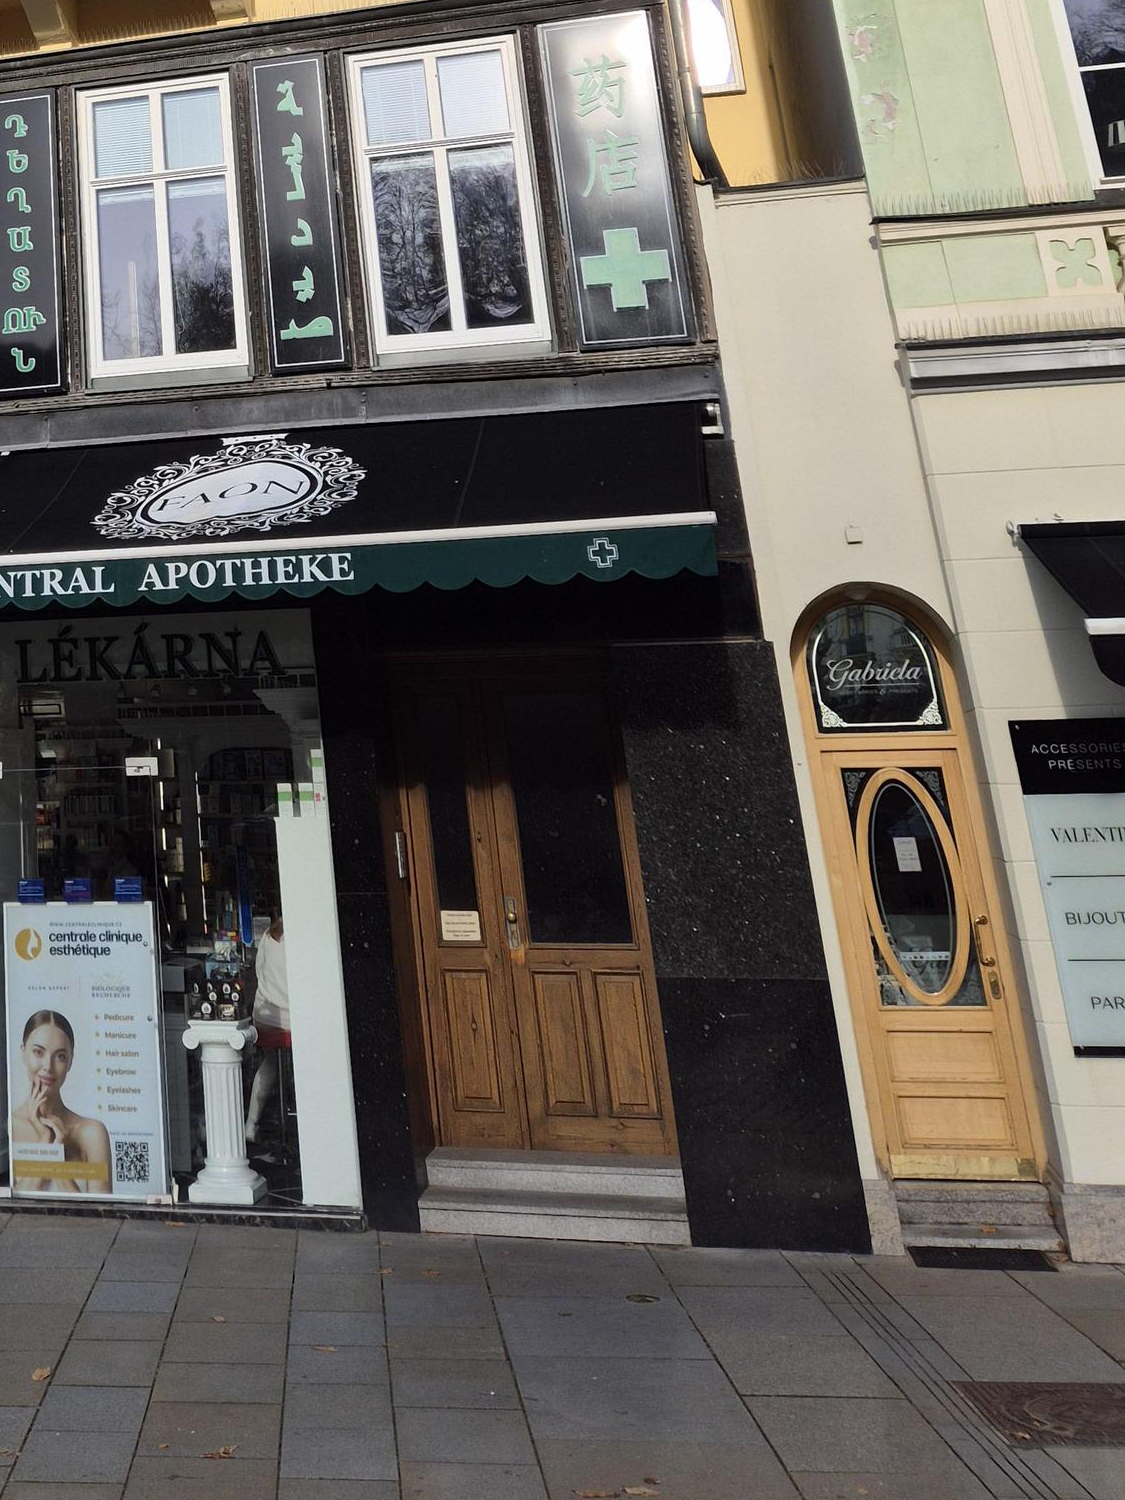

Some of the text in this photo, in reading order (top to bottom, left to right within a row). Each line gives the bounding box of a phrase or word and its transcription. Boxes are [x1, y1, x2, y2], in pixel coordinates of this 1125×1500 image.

[568, 53, 638, 198] 药店
[155, 480, 306, 512] FAON
[138, 552, 355, 592] APOTHEKE
[15, 622, 289, 683] LÉKÁRNA
[826, 658, 923, 691] Gabriela
[1031, 742, 1125, 754] ACCESSORIE
[1048, 759, 1122, 771] PRESENTS
[49, 929, 143, 945] centrale clinique
[49, 943, 111, 958] esthétique
[104, 1013, 135, 1021] Pedicure
[104, 1031, 137, 1040] Manicure
[105, 1050, 140, 1058] Hair salon
[106, 1067, 137, 1077] Eyebrow
[107, 1085, 141, 1095] Eyelashes
[108, 1104, 138, 1113] Skincare
